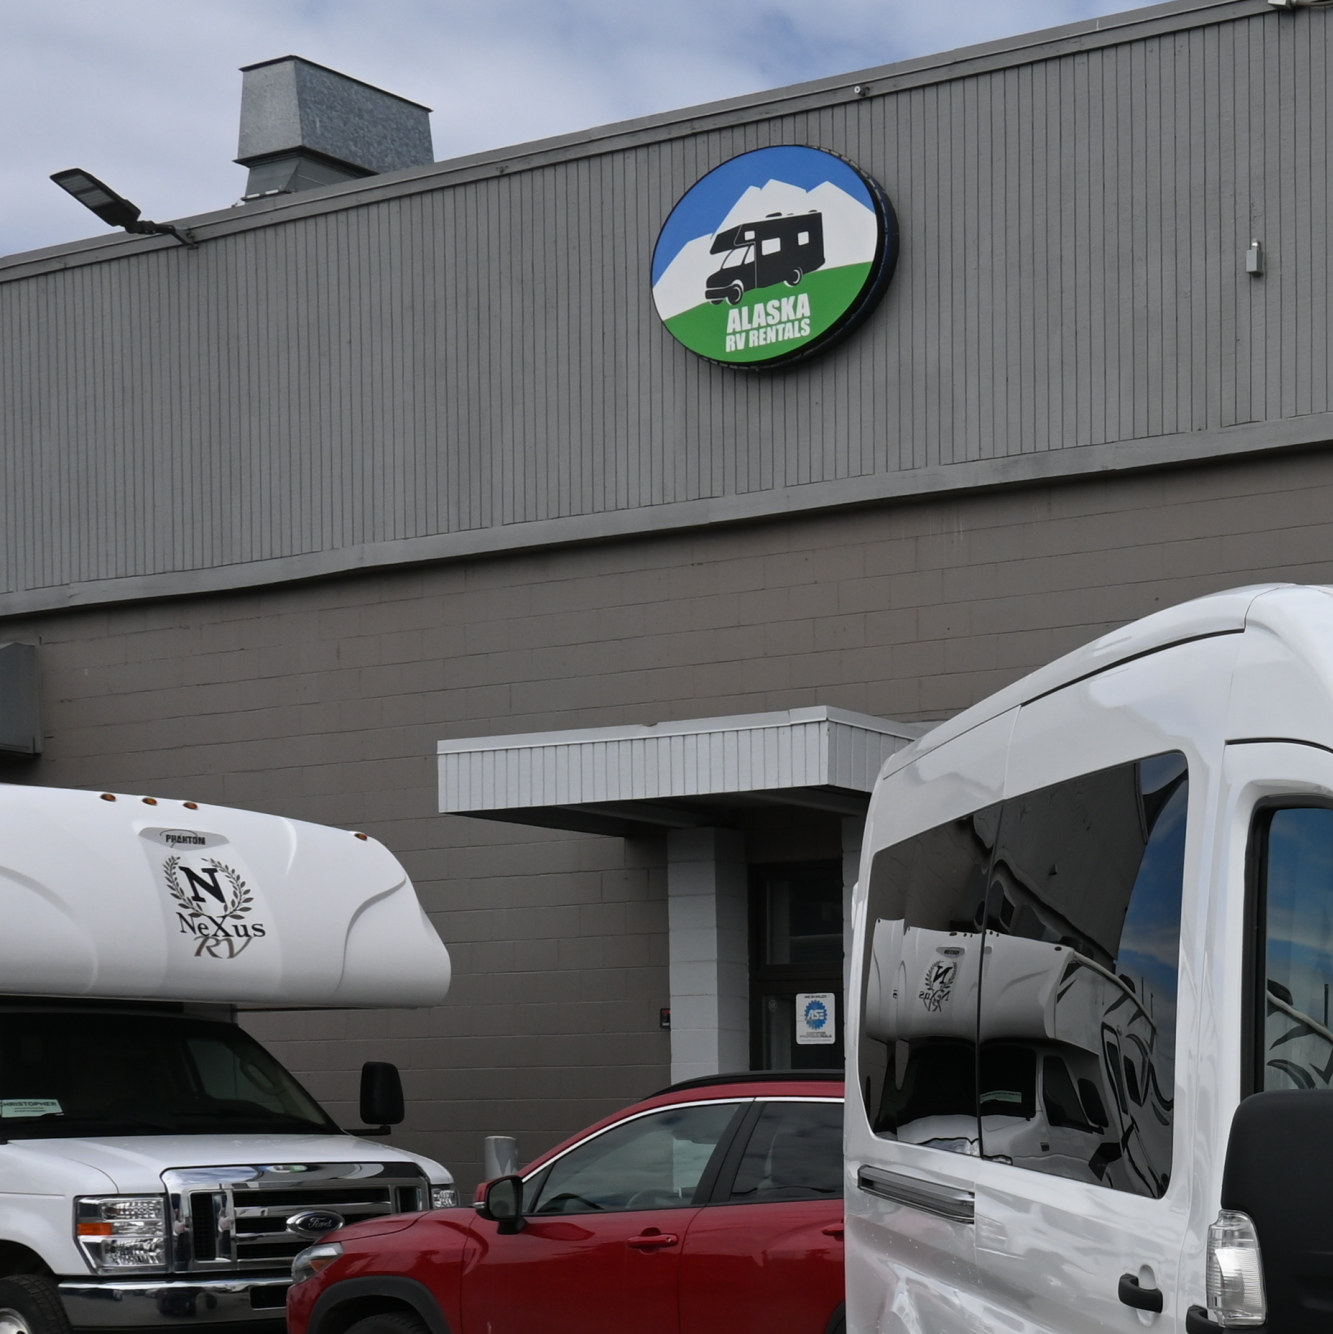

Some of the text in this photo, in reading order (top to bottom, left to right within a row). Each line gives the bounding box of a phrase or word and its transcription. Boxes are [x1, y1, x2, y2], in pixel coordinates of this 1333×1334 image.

[727, 293, 810, 334] ALASKA
[726, 318, 811, 352] RV RENTALS
[165, 834, 206, 845] PHANTOM
[178, 866, 226, 903] N
[176, 911, 266, 937] NeXus
[194, 935, 254, 959] RV
[807, 1009, 825, 1020] ASE
